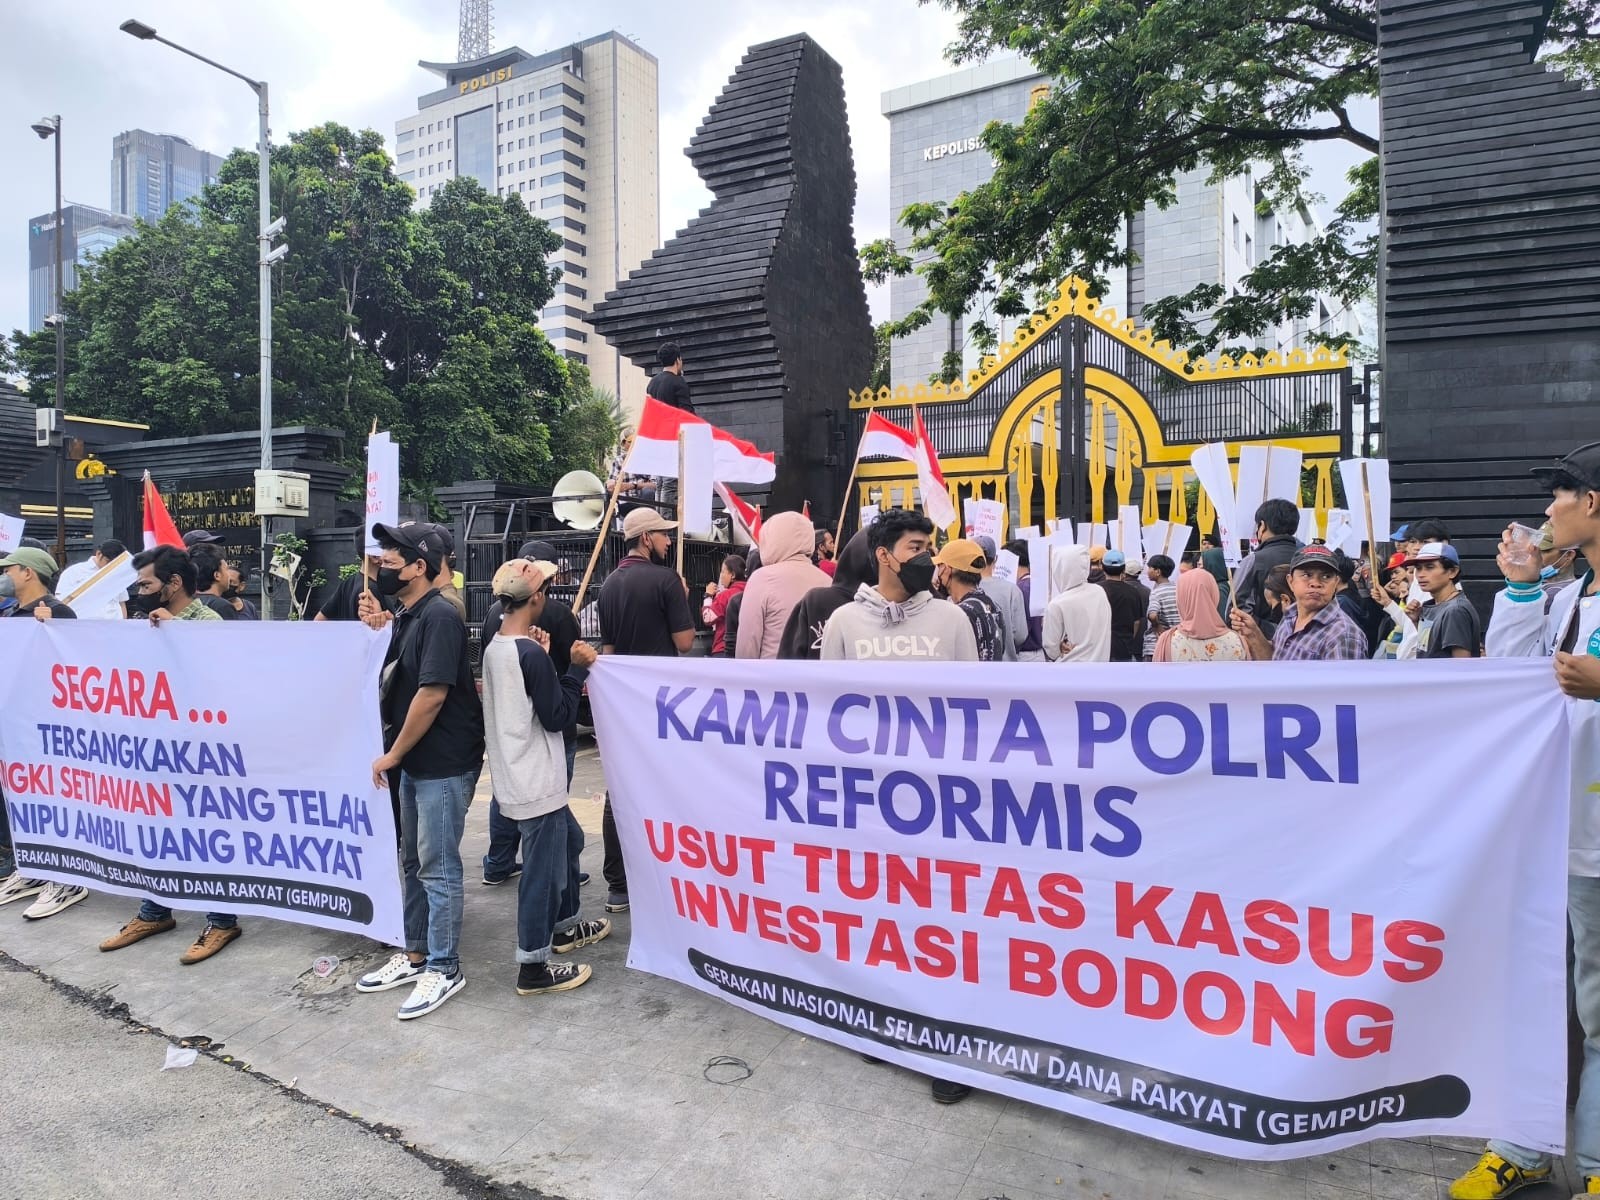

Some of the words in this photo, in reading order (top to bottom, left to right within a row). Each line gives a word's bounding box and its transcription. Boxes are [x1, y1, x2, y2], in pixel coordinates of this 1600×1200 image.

[459, 66, 512, 95] POLISI
[52, 664, 178, 720] SEGARA
[37, 724, 247, 777] TERSANGKAKAN
[656, 686, 808, 749] KAMI
[827, 693, 1053, 766] CINTA
[1074, 699, 1359, 784] POLRI
[60, 766, 173, 816] SETIAWAN
[174, 784, 275, 822] YANG
[278, 789, 374, 836] TELAH
[764, 760, 1142, 857] REFORMIS
[74, 810, 134, 856] AMBIL
[137, 825, 235, 864] UANG
[243, 831, 363, 880] RAKYAT
[61, 855, 108, 878] NASIONAL
[109, 866, 179, 892] SELAMATKAN
[183, 879, 225, 896] DANA
[229, 883, 283, 901] RAKYAT
[286, 887, 352, 916] (GEMPUR)
[643, 819, 775, 884] USUT
[793, 842, 1086, 930] TUNTAS
[1115, 880, 1446, 984] KASUS
[671, 876, 980, 984] INVESTASI
[1009, 937, 1395, 1059] BODONG
[703, 962, 776, 1002] GERAKAN
[782, 986, 878, 1033] NASIONAL
[884, 1016, 1039, 1074] SELAMATKAN
[1048, 1055, 1122, 1097] DANA
[1130, 1077, 1247, 1129] RAKYAT
[1256, 1094, 1406, 1138] (GEMPUR)
